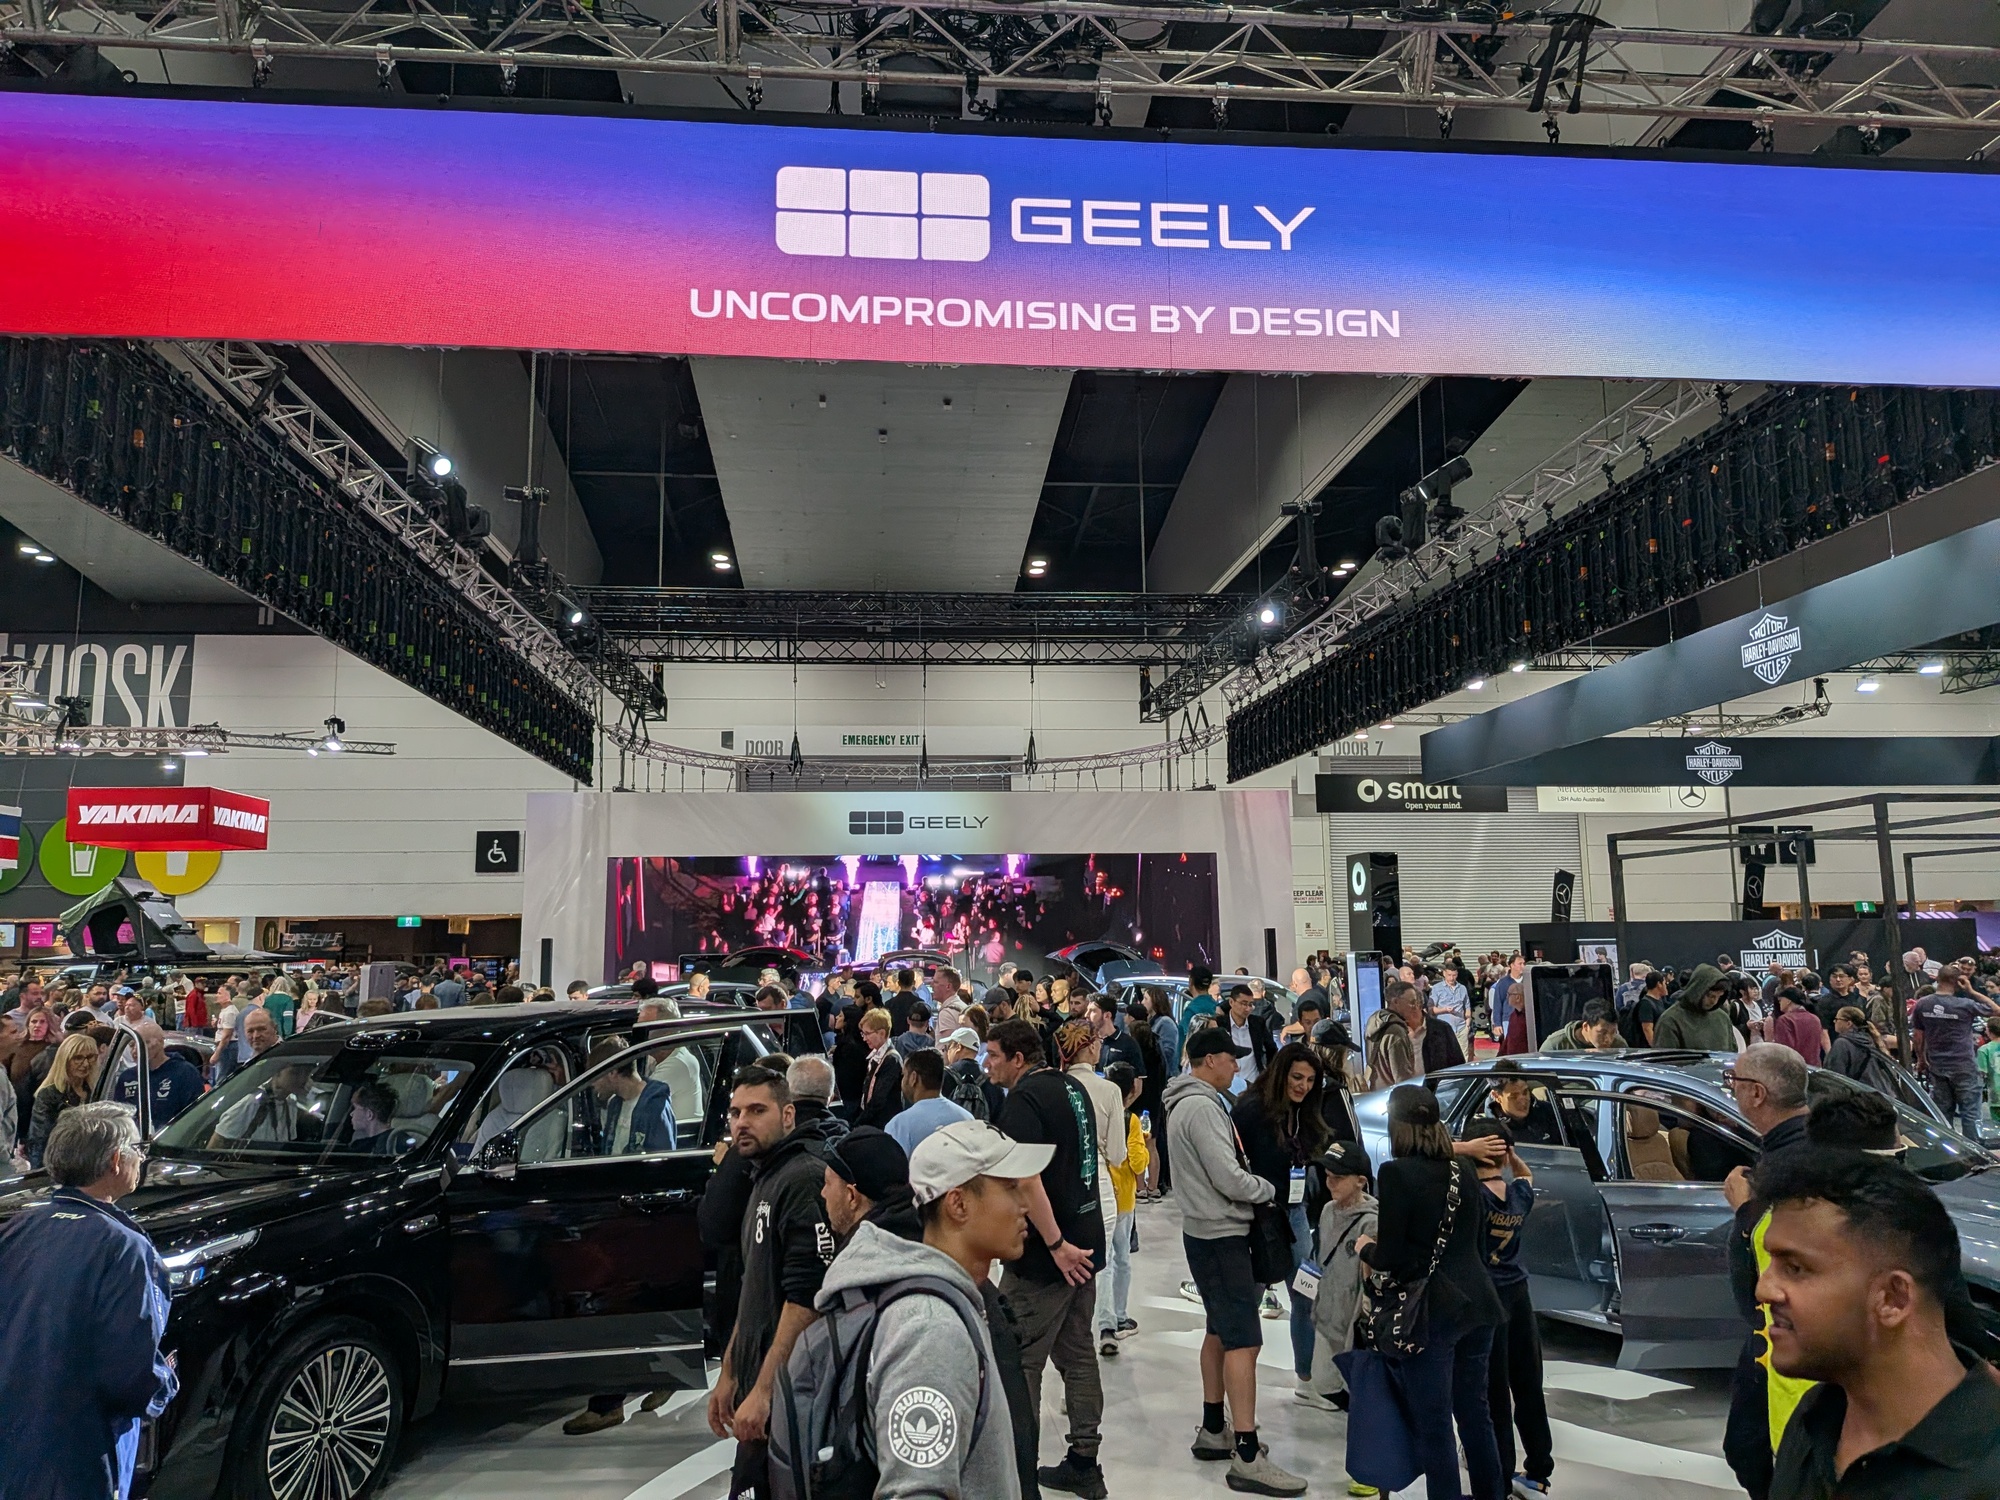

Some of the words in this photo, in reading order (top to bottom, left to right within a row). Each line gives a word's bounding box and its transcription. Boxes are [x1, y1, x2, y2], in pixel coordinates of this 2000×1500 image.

[1011, 197, 1315, 250] GEELY
[690, 288, 1136, 333] UNCOMPROMISING
[1149, 304, 1214, 335] BY
[1229, 306, 1400, 338] DESIGN
[1754, 618, 1783, 640] MOTOR
[1744, 632, 1798, 663] HARLEY-DAVIDSON
[1758, 656, 1786, 680] CYCLES
[5, 644, 188, 756] KIOSK
[745, 740, 784, 756] DOOR
[842, 734, 896, 746] EMERGENCY
[900, 734, 920, 746] EXIT
[1333, 740, 1369, 756] DOOR
[1375, 741, 1384, 756] 7
[1699, 744, 1727, 755] MOTOR
[1688, 757, 1740, 768] HARLEY-DAVIDSON
[1701, 770, 1729, 782] CYCLES
[1387, 782, 1462, 800] smart
[78, 804, 199, 824] YAKIMA
[1405, 802, 1423, 810] Open
[213, 806, 266, 833] YAKIMA
[909, 816, 989, 829] GEELY
[1760, 934, 1797, 949] MOTOR
[1744, 953, 1807, 968] HARLEY-DAVIDS
[755, 1217, 764, 1244] 8
[1490, 1229, 1514, 1250] 7
[1300, 1279, 1314, 1289] VIP
[893, 1438, 946, 1463] ADIDAS
